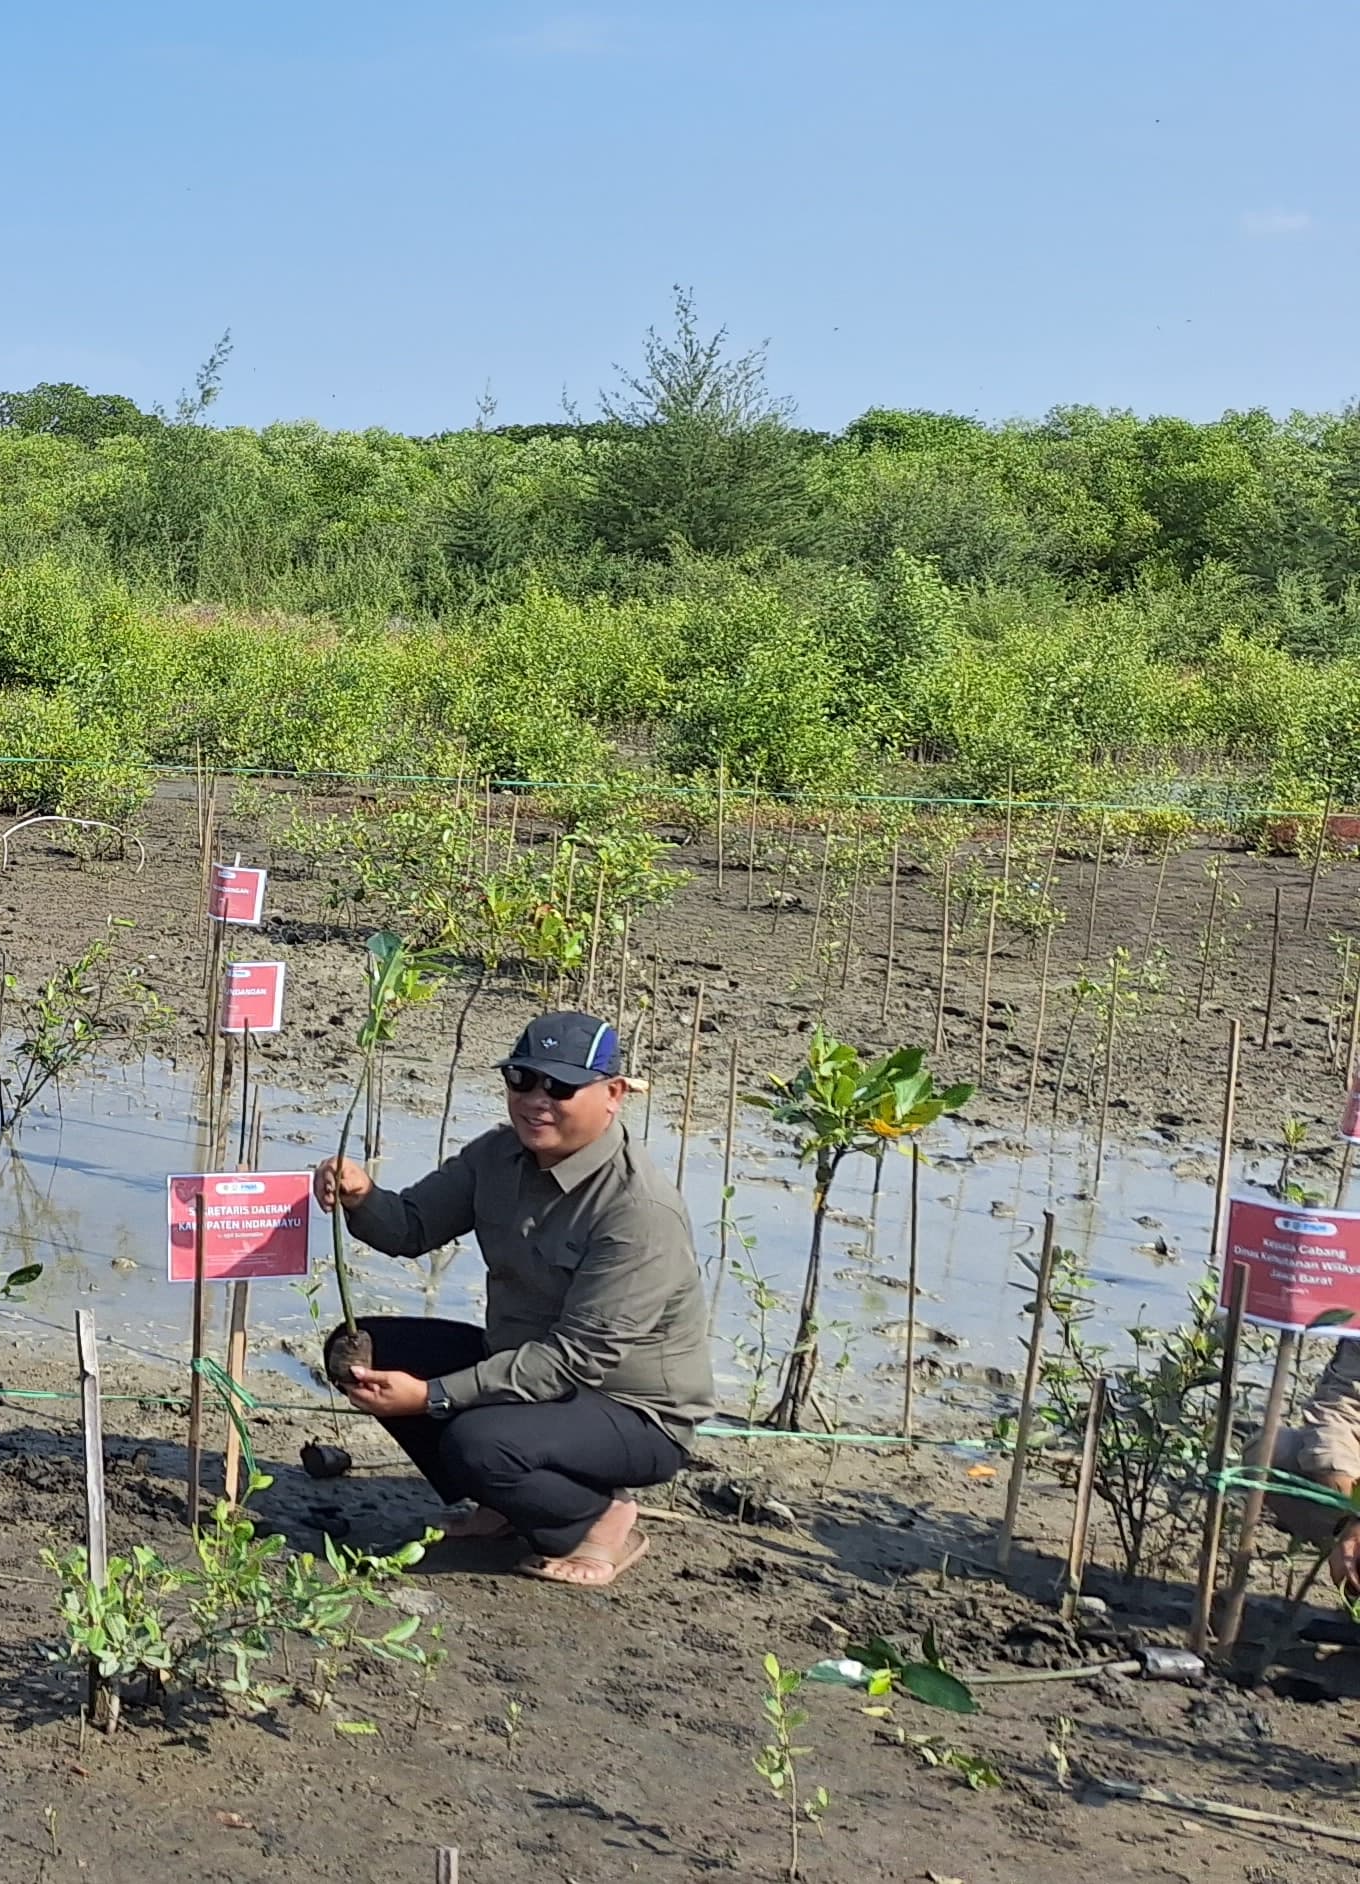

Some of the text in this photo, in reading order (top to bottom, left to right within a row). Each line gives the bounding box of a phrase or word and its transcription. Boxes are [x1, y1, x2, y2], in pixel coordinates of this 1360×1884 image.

[189, 1204, 292, 1217] SRETARIS DAERAH
[178, 1218, 301, 1231] KAPATEN INDRAMAYU
[1298, 1245, 1347, 1260] Cabang
[1298, 1273, 1334, 1286] Barat
